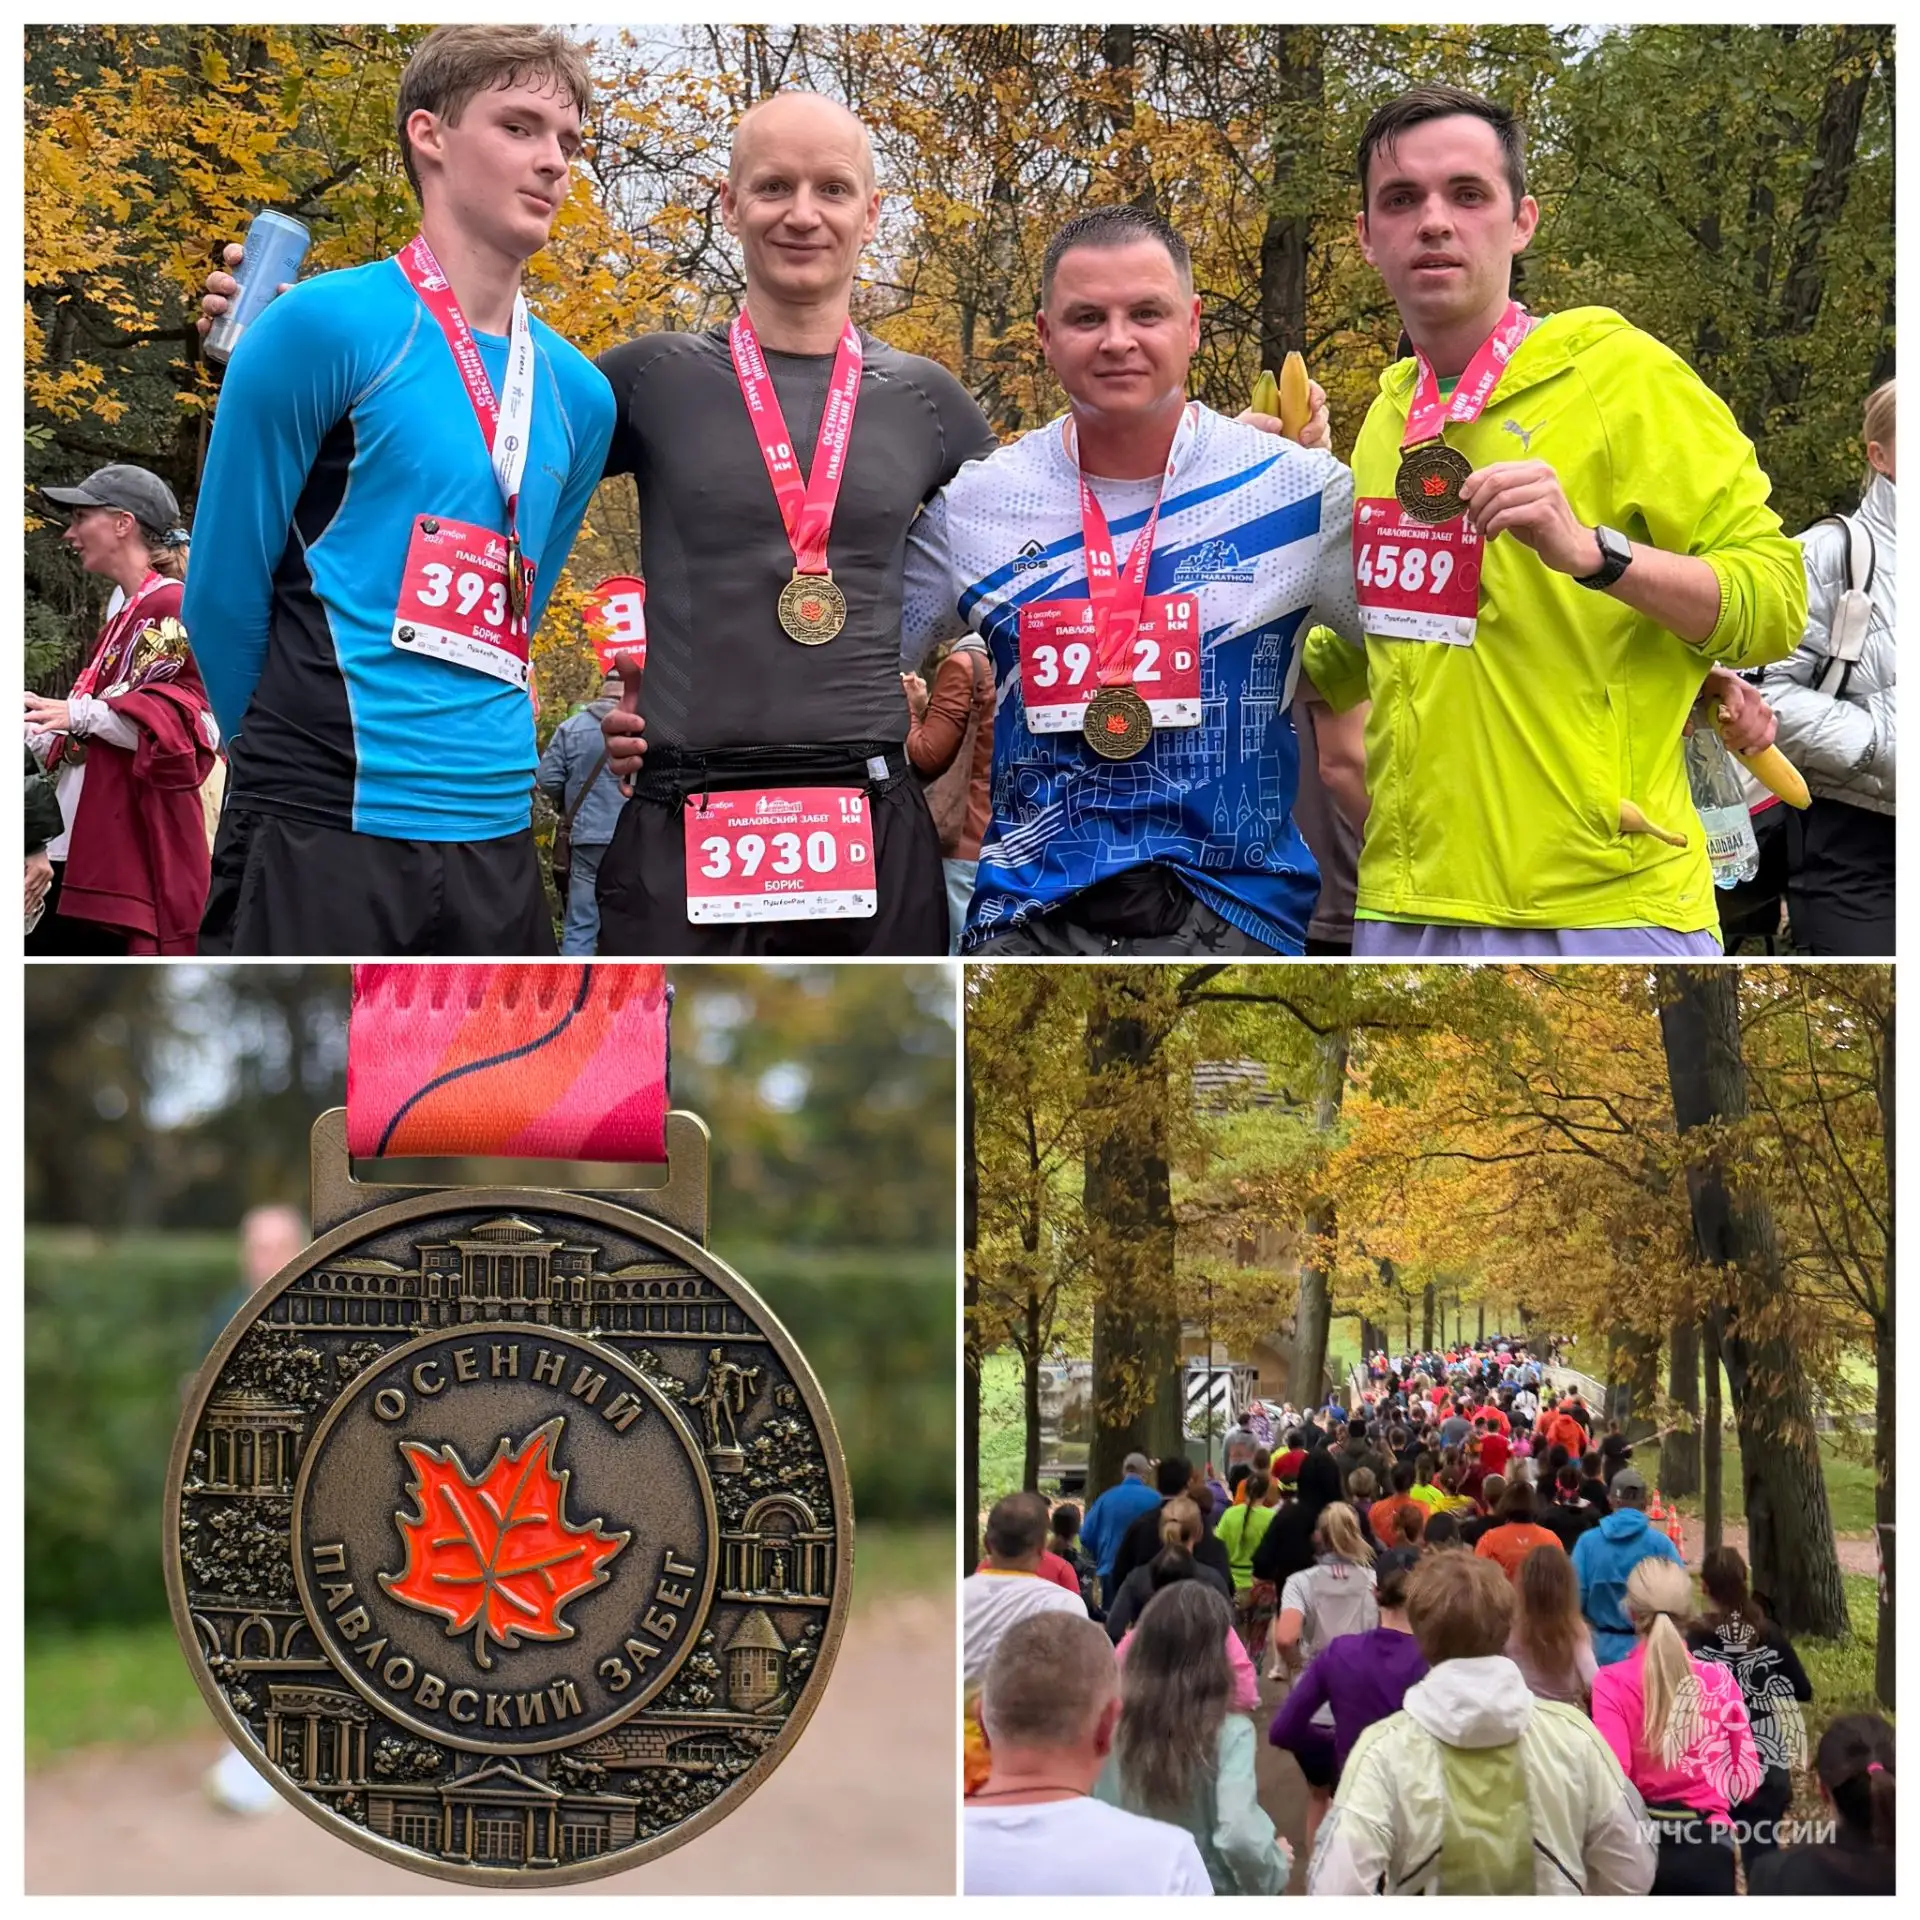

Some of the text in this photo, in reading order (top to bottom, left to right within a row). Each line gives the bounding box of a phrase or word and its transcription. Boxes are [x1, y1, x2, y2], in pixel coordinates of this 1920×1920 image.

[742, 329, 766, 380] ОСЕННИЙ
[447, 307, 500, 424] ВЛОВСКИЙ ЗАБЕГ
[454, 340, 486, 407] ОСЕННИЙ
[744, 378, 764, 412] ЗАБЕГ
[1471, 369, 1495, 405] ЗАБЕГ
[823, 388, 842, 446] ОСЕННИЙ
[826, 367, 858, 480] ПАВЛОВСКИЙ ЗАБЕГ
[766, 443, 790, 461] 10
[1377, 527, 1454, 541] ПАВЛОВСКИЙ ЗАБЕГ
[1461, 534, 1477, 545] КМ
[455, 550, 507, 576] ПАВЛОВСК
[1089, 549, 1111, 566] 10
[1013, 560, 1048, 575] IROS
[1357, 544, 1454, 594] 4589
[1177, 573, 1253, 582] HALF MARATHON
[416, 562, 518, 635] 393
[1165, 602, 1191, 620] 10
[472, 624, 502, 644] БОРИС
[1056, 625, 1096, 635] ПАВЛОВ
[1167, 621, 1188, 631] КМ
[1032, 639, 1162, 687] 392
[1175, 651, 1191, 670] D
[838, 797, 863, 814] 10
[728, 814, 830, 827] ПАВЛОВСКИЙ ЗАБЕГ
[842, 814, 861, 824] КМ
[700, 831, 837, 879] 3930
[850, 844, 866, 862] D
[765, 879, 804, 891] БОРИС
[374, 1345, 644, 1432] ОСЕННИЙ
[313, 1543, 697, 1728] ПАВЛОВСКИЙ ЗАБЕГ
